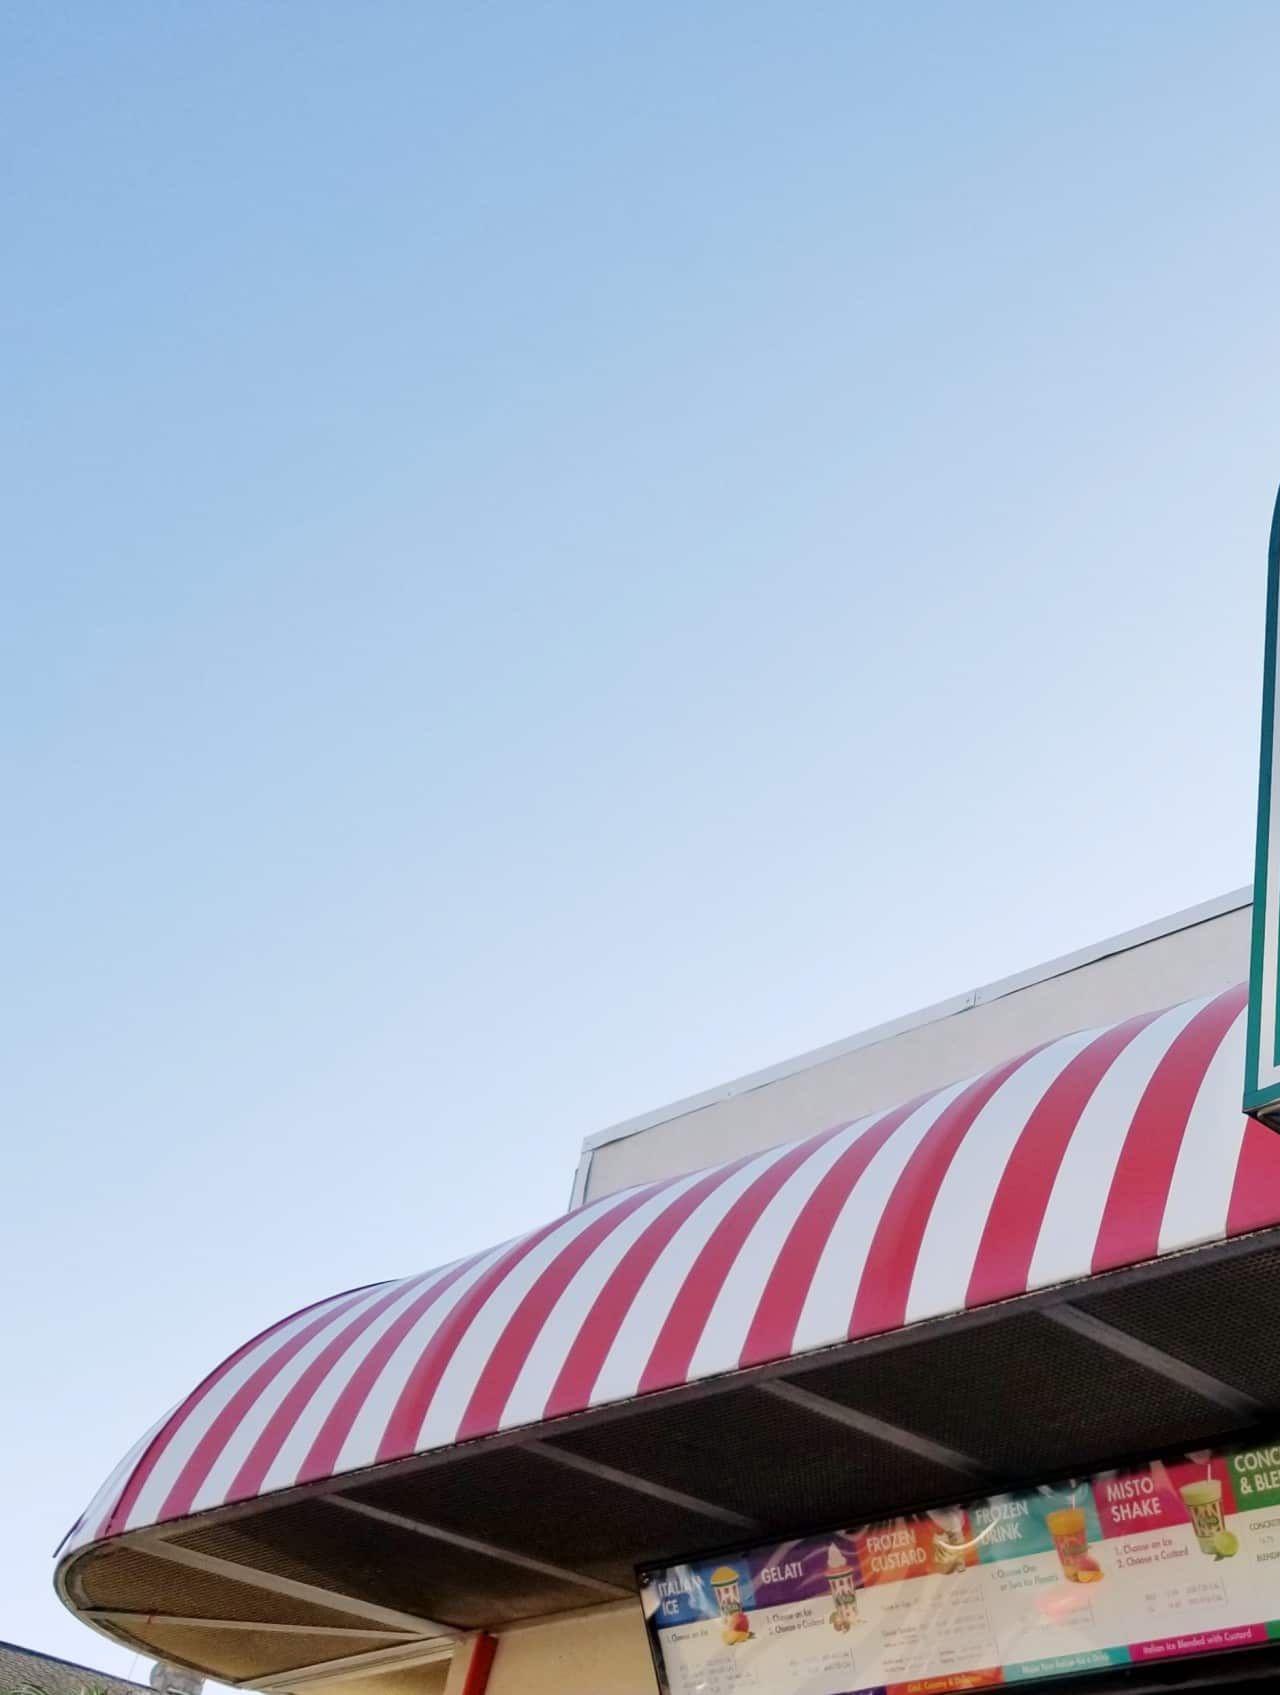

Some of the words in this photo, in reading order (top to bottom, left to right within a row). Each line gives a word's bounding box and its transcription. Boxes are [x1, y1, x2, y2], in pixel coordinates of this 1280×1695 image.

[1107, 1477, 1153, 1502] MISTO
[1240, 1476, 1253, 1495] &
[975, 1501, 1029, 1525] FROZEN
[1111, 1497, 1162, 1522] SHAKE
[866, 1529, 916, 1553] FROZEN
[1123, 1543, 1149, 1554] Choose
[1151, 1541, 1161, 1549] an
[1162, 1536, 1173, 1546] Ice
[871, 1548, 927, 1573] CUSTARD
[1126, 1555, 1152, 1567] Choose
[1160, 1546, 1189, 1560] Custard
[761, 1561, 803, 1584] GELATI
[661, 1599, 680, 1616] ICE
[1177, 1637, 1206, 1649] Blended
[1207, 1634, 1223, 1644] with
[1224, 1628, 1252, 1641] Custard
